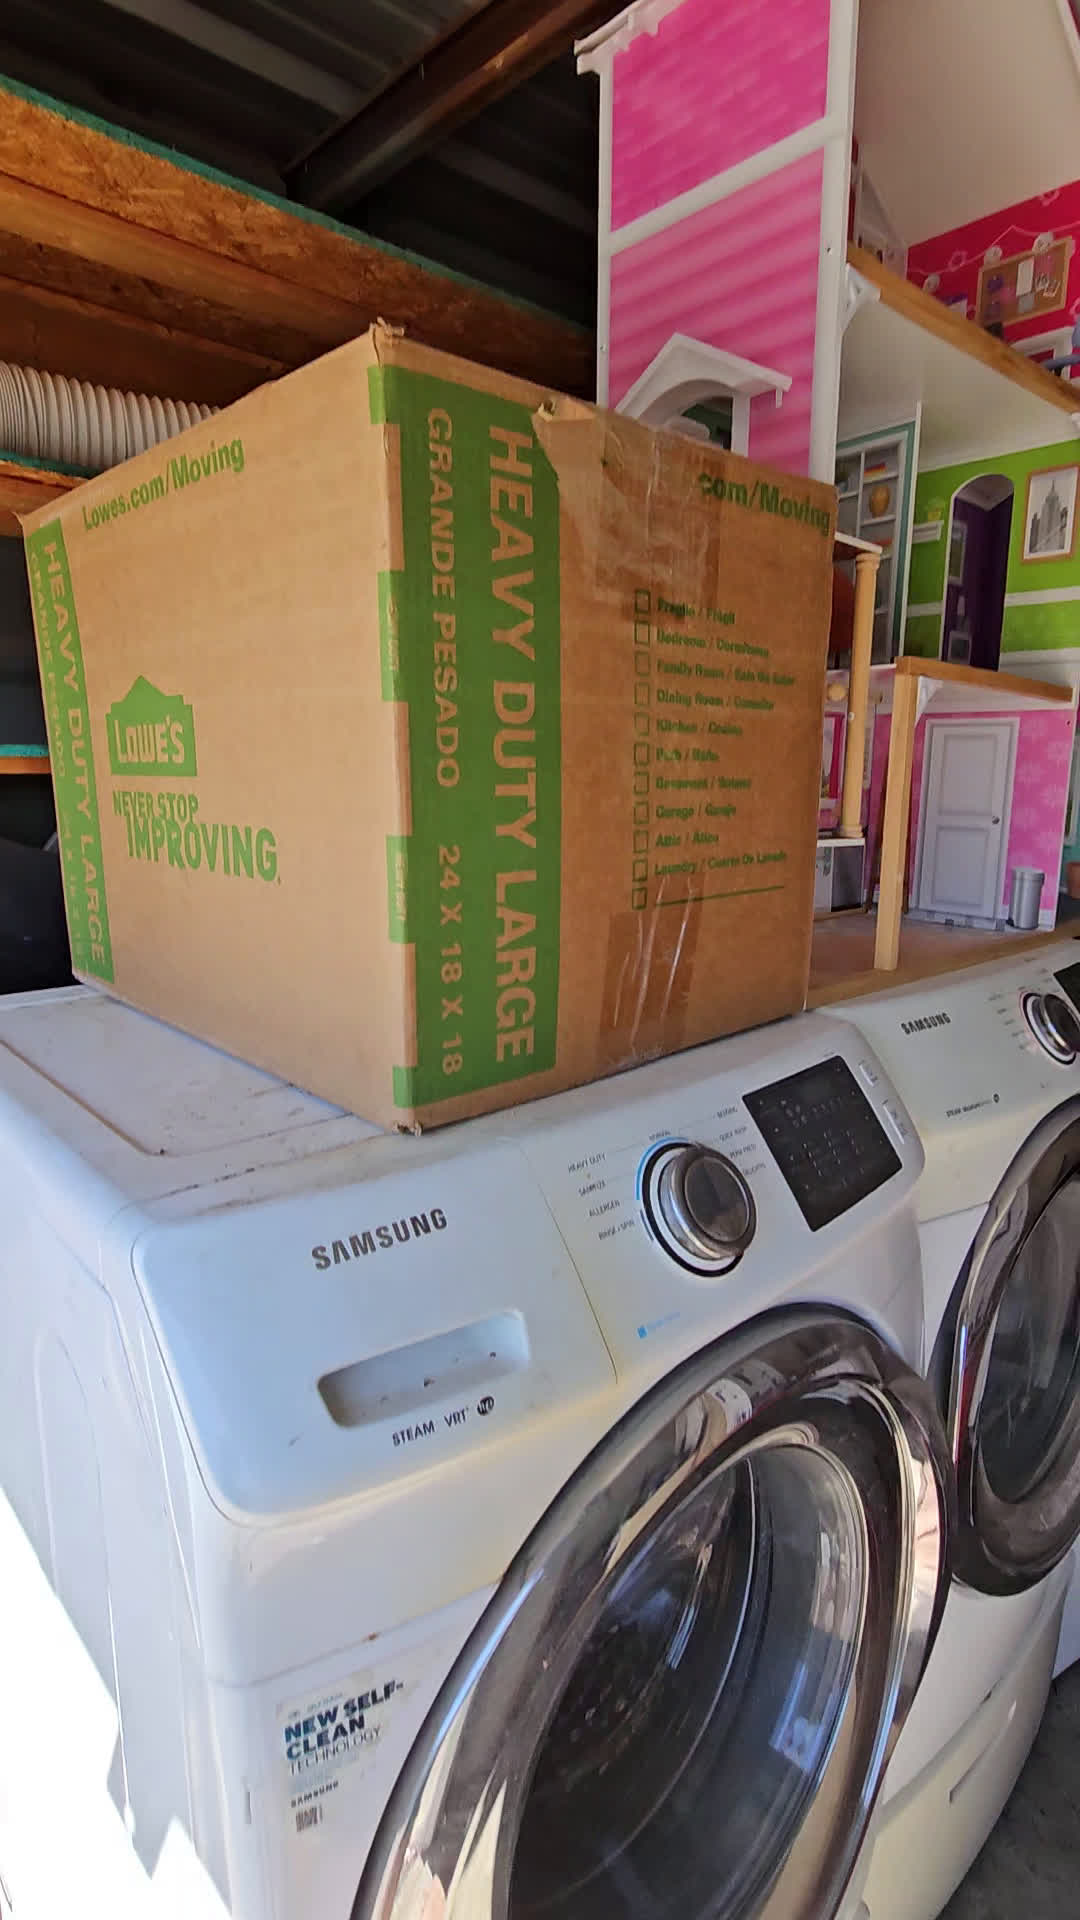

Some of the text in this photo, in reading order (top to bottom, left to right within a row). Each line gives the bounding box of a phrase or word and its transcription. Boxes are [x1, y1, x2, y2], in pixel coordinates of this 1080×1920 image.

[82, 437, 245, 532] Lowes.com/Moving
[44, 541, 79, 691] HEAVY
[67, 708, 91, 820] DUTY
[80, 835, 106, 964] LARGE
[427, 407, 464, 1076] GRANDE PESADO 24 X 18 X 18
[489, 425, 537, 1062] HEAVY DUTY LARGE
[112, 789, 199, 823] NEVER STOP
[901, 1012, 951, 1035] SAMSUNG
[311, 1208, 447, 1270] SAMSUNG
[392, 1420, 436, 1447] STEAM
[284, 1705, 338, 1743] NEW
[286, 1714, 365, 1761] CLEAN
